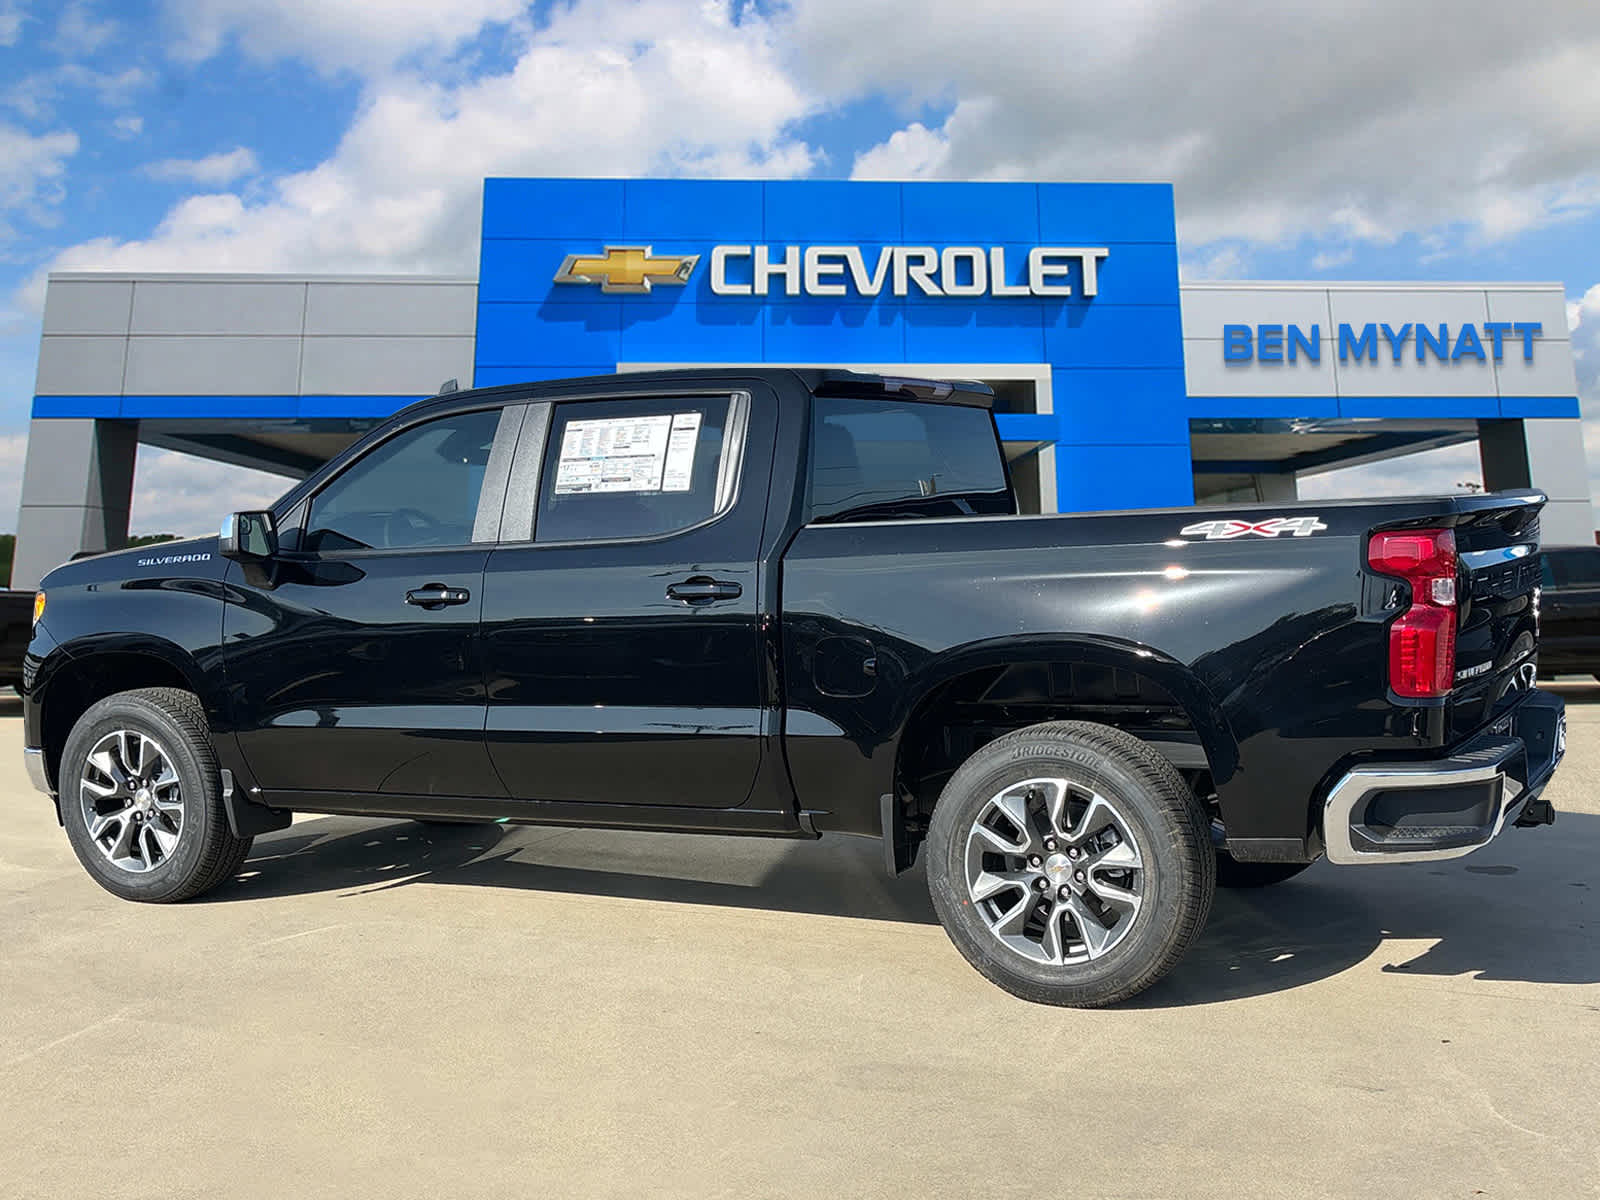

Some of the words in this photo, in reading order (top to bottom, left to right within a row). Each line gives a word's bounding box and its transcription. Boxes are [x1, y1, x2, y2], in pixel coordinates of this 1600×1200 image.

[710, 245, 1109, 297] CHEVROLET
[1223, 324, 1321, 363] BEN
[1339, 322, 1543, 363] MYNATT
[137, 552, 211, 567] SILVERADO
[1011, 743, 1104, 770] BRIDGESTONE
